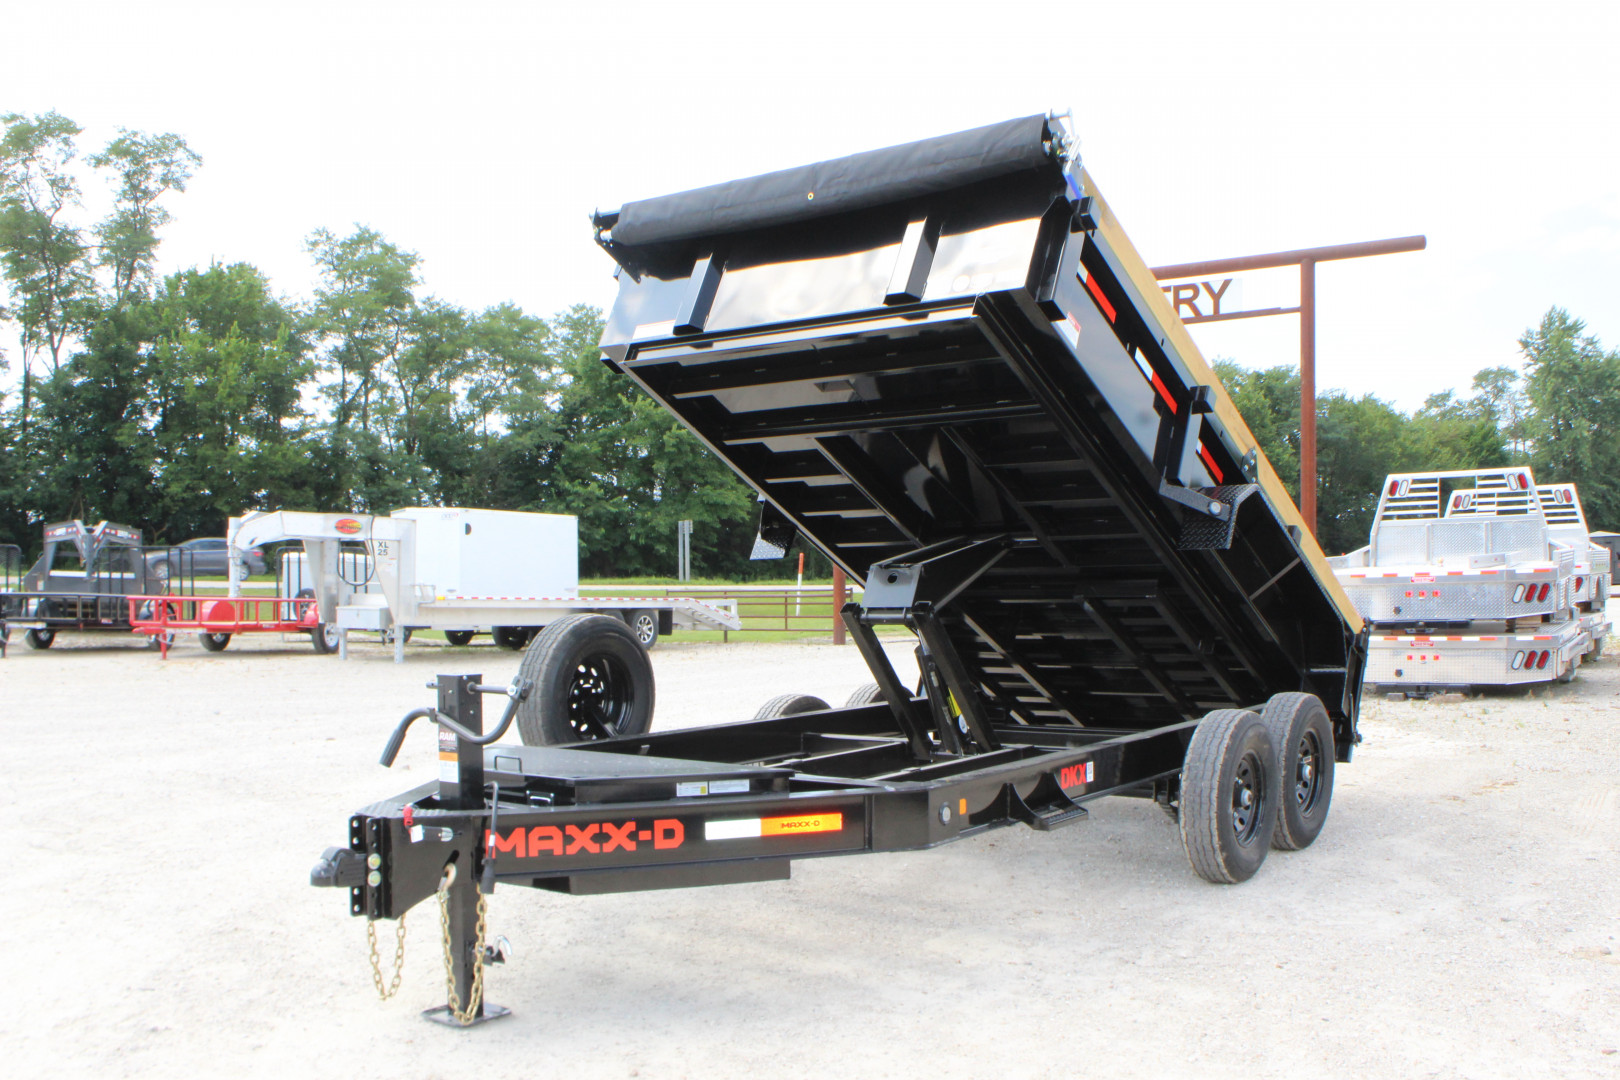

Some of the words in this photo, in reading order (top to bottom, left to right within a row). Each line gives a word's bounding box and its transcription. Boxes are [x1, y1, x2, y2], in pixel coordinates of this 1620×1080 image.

[1161, 278, 1233, 318] RY
[377, 541, 389, 549] XL
[439, 731, 456, 742] RAM
[1061, 762, 1087, 790] DKX
[781, 820, 820, 829] MAXX-D
[485, 818, 685, 860] MAXX-D
